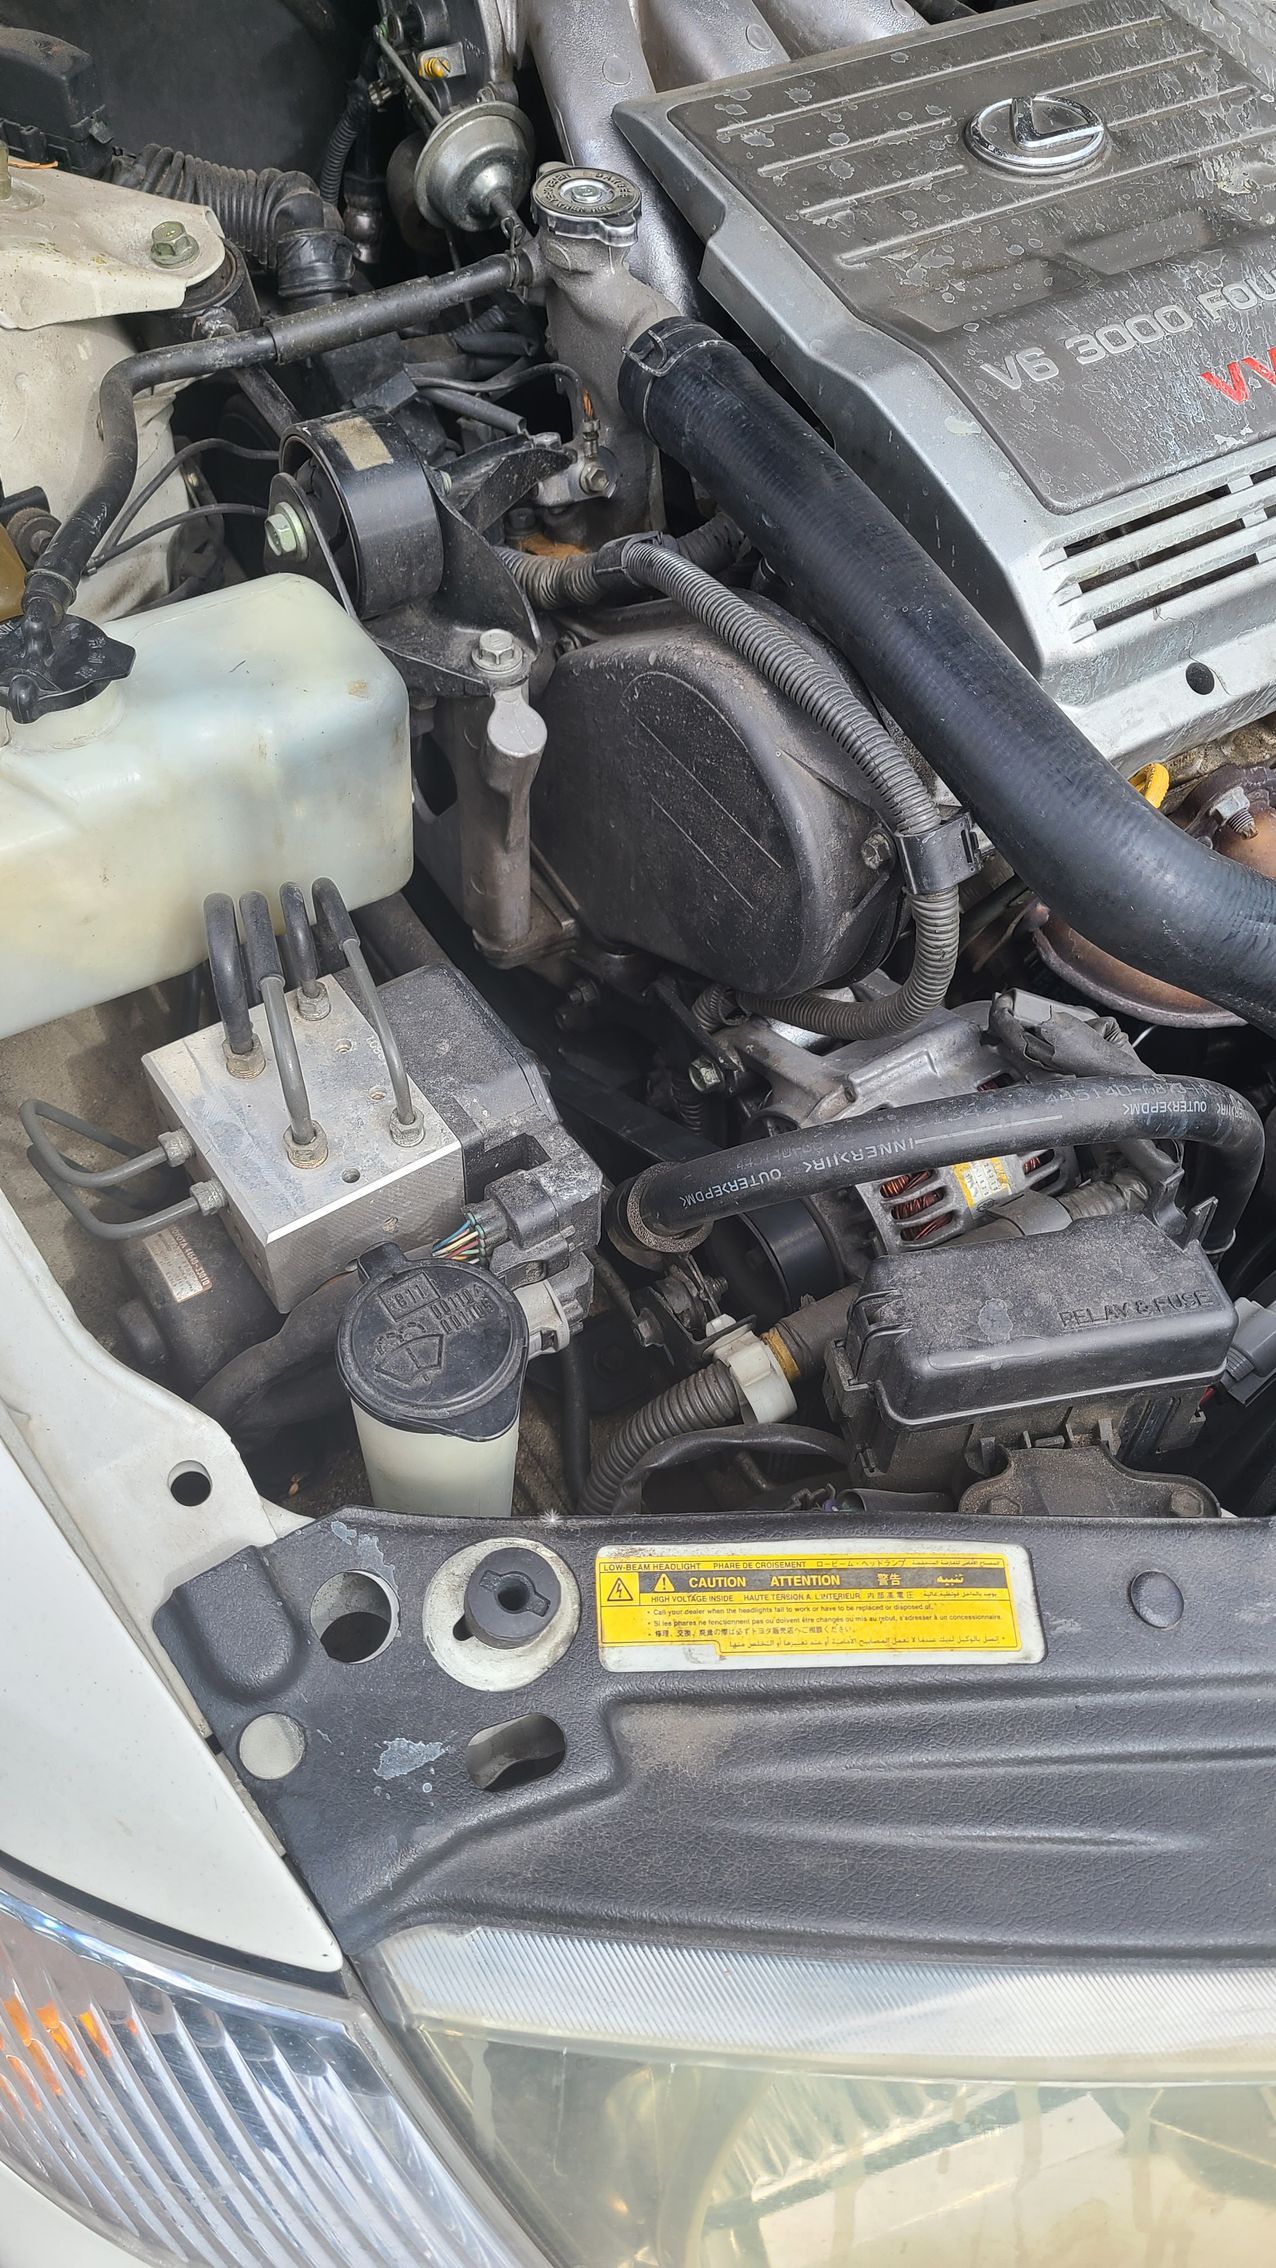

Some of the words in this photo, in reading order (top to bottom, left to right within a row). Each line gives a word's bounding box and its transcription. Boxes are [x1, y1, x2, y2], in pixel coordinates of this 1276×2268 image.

[979, 346, 1060, 390] V6
[1064, 304, 1194, 365] 3000
[1058, 1302, 1128, 1327] RELAY
[1135, 1300, 1153, 1316] &
[1153, 1289, 1214, 1313] FUSE
[603, 1564, 650, 1572] LOW-BEAM
[653, 1563, 701, 1571] HEADLIGHT
[755, 1561, 807, 1569] CROISEMENT
[688, 1576, 747, 1589] CAUTION
[770, 1575, 841, 1588] ATTENTION
[877, 1573, 902, 1586] 警告
[651, 1595, 670, 1603] HIGH
[672, 1594, 707, 1603] VOLTAGE
[709, 1594, 734, 1602] INSIDE
[770, 1593, 804, 1601] TENSION
[738, 1606, 772, 1614] headlights
[856, 1604, 884, 1612] replaced
[673, 1619, 697, 1627] phares
[708, 1618, 750, 1626] fonctionnent
